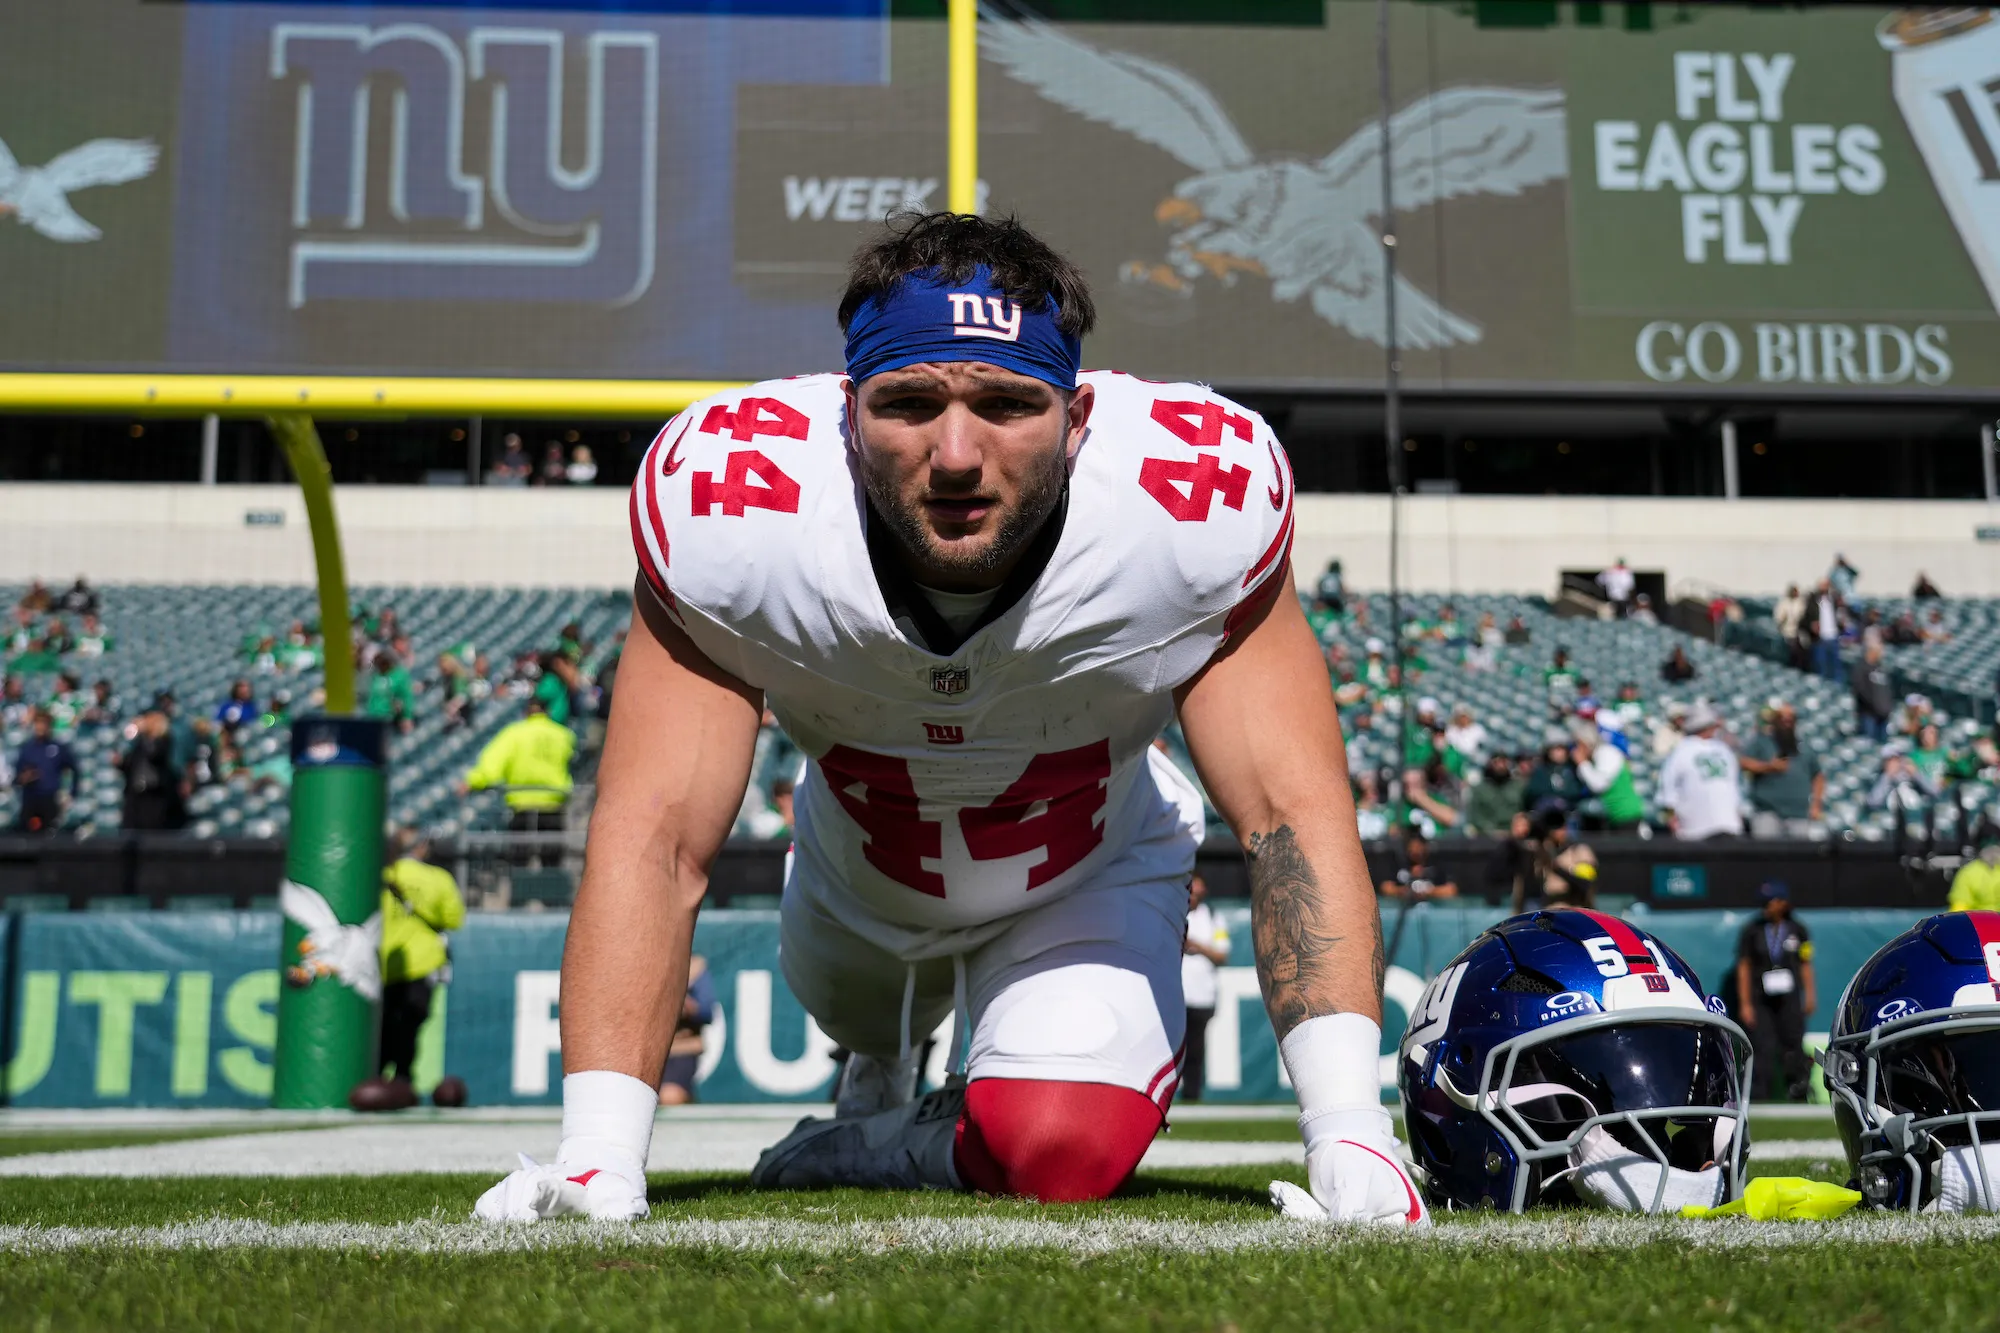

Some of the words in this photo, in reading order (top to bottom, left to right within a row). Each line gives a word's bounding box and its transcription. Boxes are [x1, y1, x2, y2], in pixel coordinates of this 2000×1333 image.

[1673, 51, 1795, 121] FLY
[1594, 120, 1887, 195] EAGLES
[784, 175, 938, 222] WEEK
[1681, 194, 1805, 265] FLY
[1635, 320, 1743, 383] GO
[1754, 322, 1954, 386] BIRDS
[691, 397, 811, 518] 44
[1138, 398, 1254, 522] 44
[936, 679, 963, 692] NFL
[817, 737, 1112, 899] 44
[1540, 1000, 1596, 1022] OAKLEY
